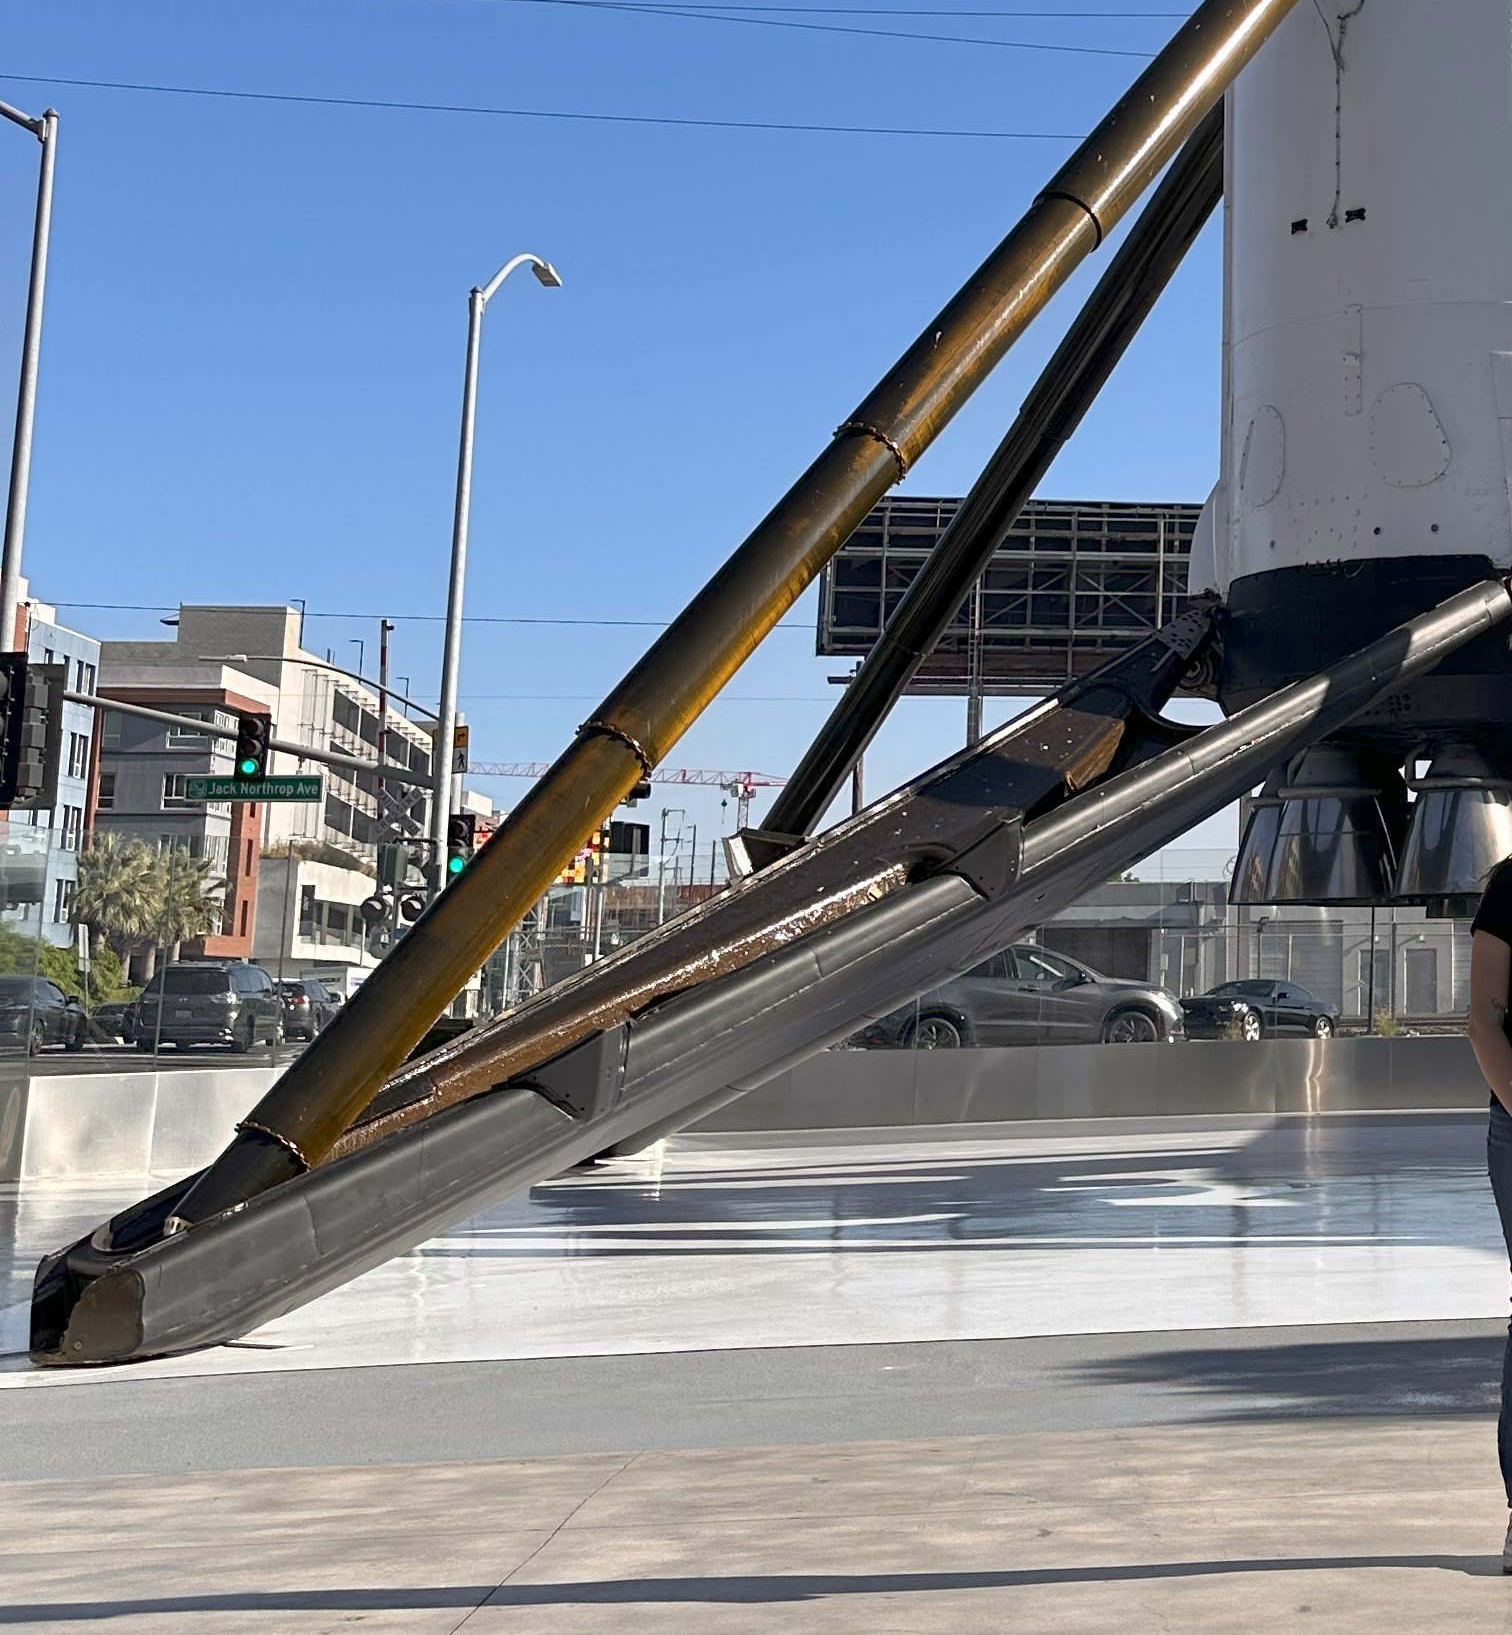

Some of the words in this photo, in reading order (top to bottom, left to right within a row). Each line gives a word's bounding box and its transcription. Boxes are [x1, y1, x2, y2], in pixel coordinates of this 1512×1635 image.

[208, 782, 236, 795] Jack
[240, 782, 294, 797] Northrop
[296, 782, 318, 795] Ave
[375, 789, 421, 833] CROSSING
